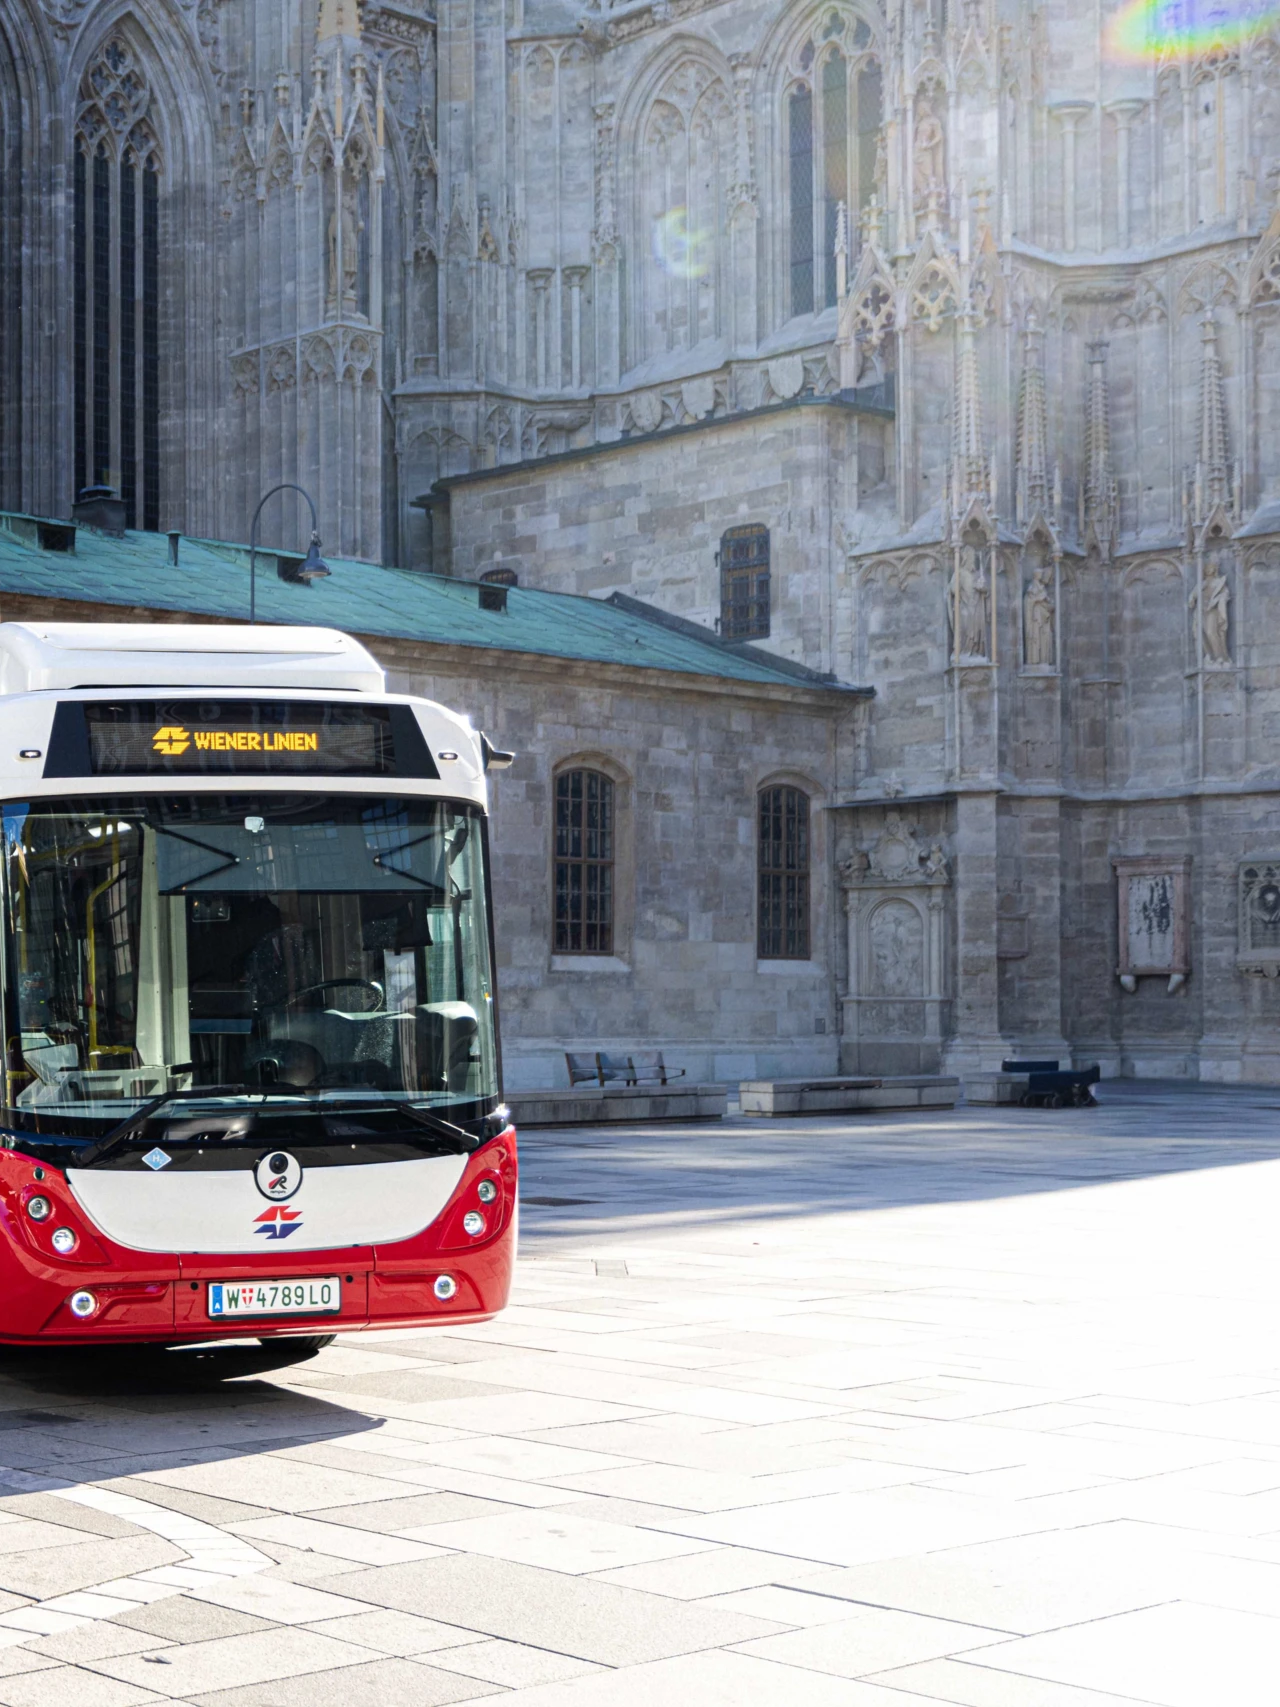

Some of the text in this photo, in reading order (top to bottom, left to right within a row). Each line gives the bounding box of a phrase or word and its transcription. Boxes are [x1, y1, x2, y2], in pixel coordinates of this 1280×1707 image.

[193, 732, 318, 751] WIENER LINIEN
[227, 1288, 240, 1309] W
